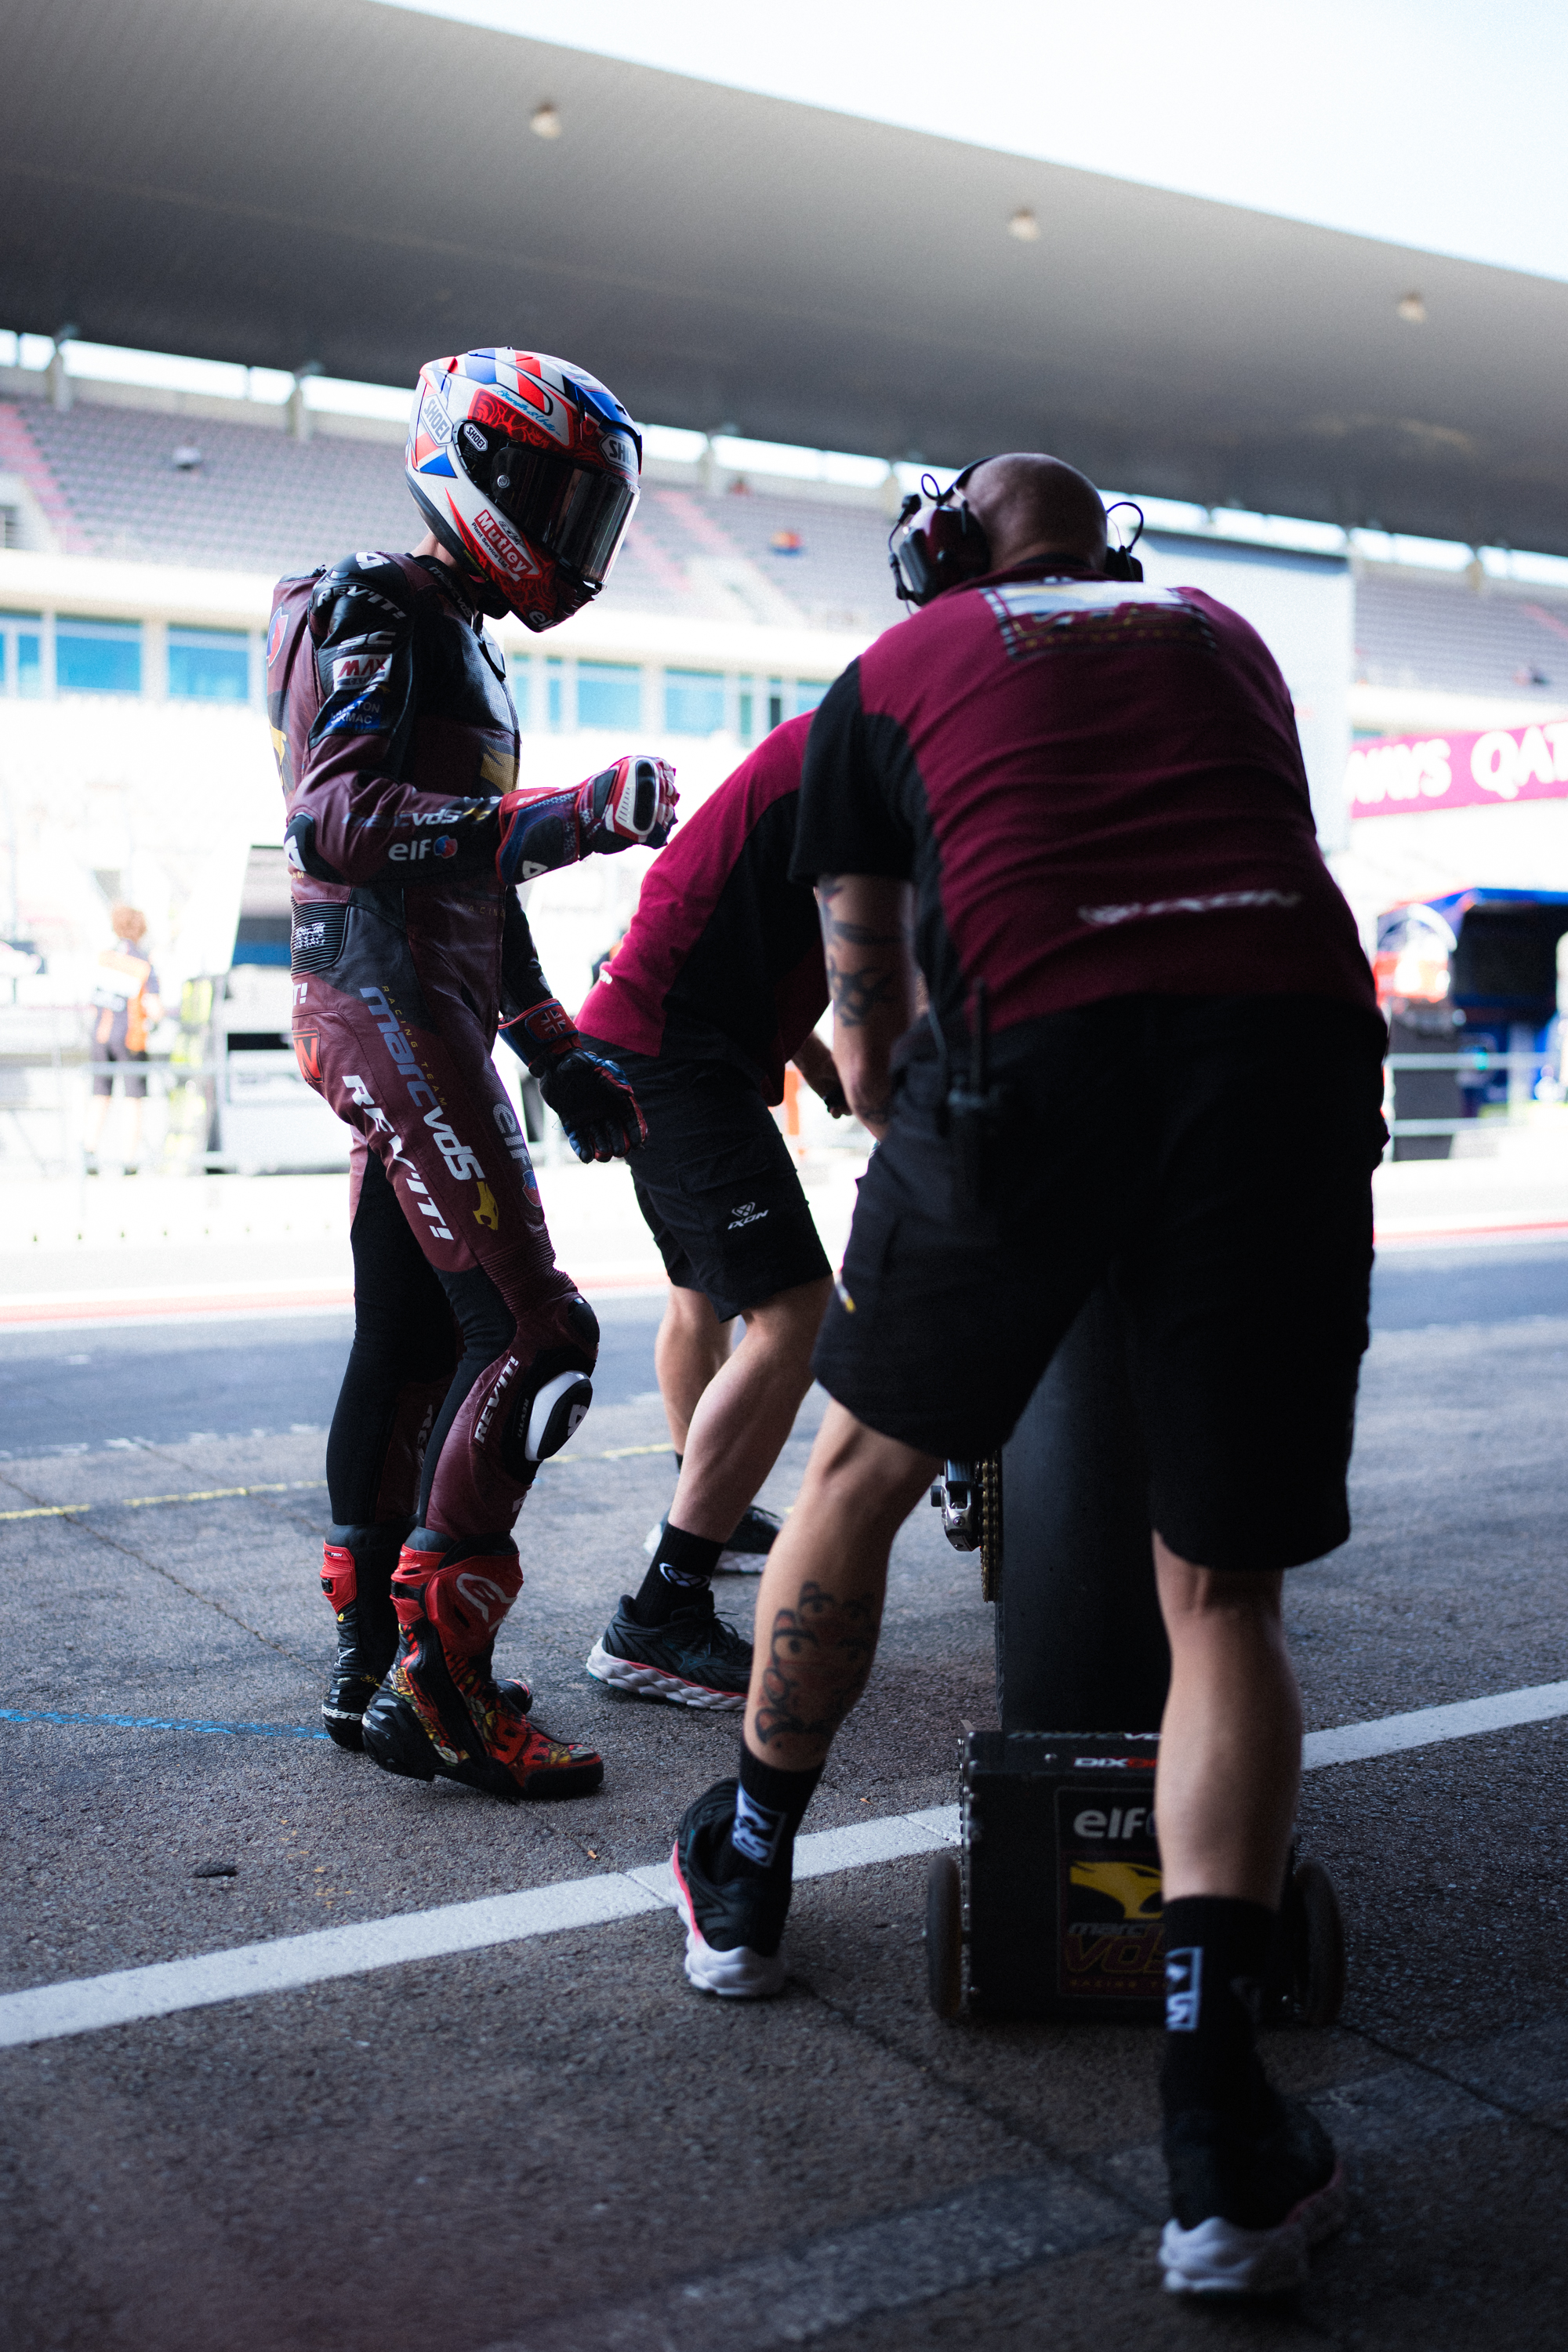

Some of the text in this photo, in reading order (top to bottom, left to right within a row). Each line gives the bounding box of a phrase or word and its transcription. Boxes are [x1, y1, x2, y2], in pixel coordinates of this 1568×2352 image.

[423, 401, 450, 441] SHOEI
[466, 425, 485, 448] SHOEI
[471, 522, 483, 539] Plant
[481, 537, 499, 559] Service
[497, 557, 508, 568] Ltd
[477, 511, 528, 572] Mutley
[337, 631, 397, 650] SC
[338, 658, 386, 677] MAX
[389, 839, 431, 862] elf
[382, 985, 448, 1105] RACING TEAM
[493, 1103, 532, 1167] elf
[342, 1075, 454, 1240] REV'IT!
[728, 1210, 769, 1230] IXON
[474, 1356, 520, 1443] REV'IT!
[1073, 1807, 1147, 1840] elf
